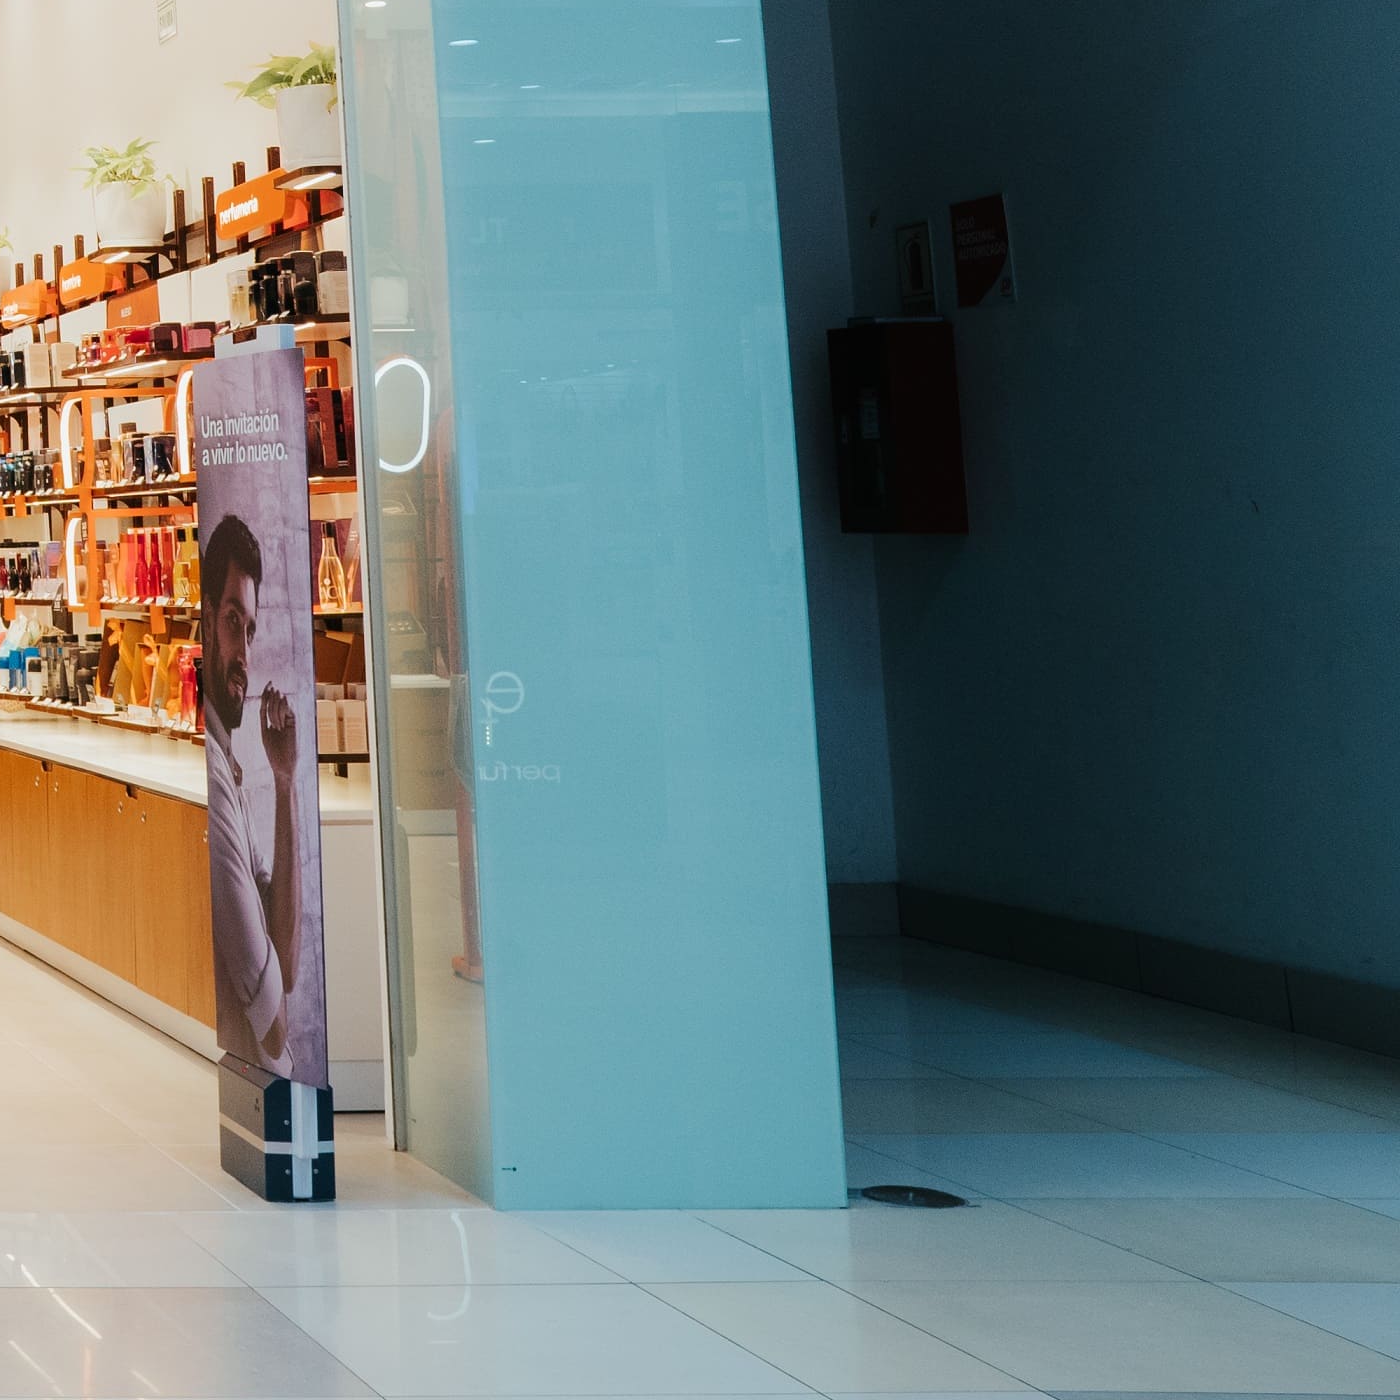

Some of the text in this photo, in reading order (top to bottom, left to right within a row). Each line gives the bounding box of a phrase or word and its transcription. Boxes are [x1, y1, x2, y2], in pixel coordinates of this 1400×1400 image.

[201, 408, 279, 438] Una invitación
[202, 440, 288, 467] a vivir lo nuevo.
